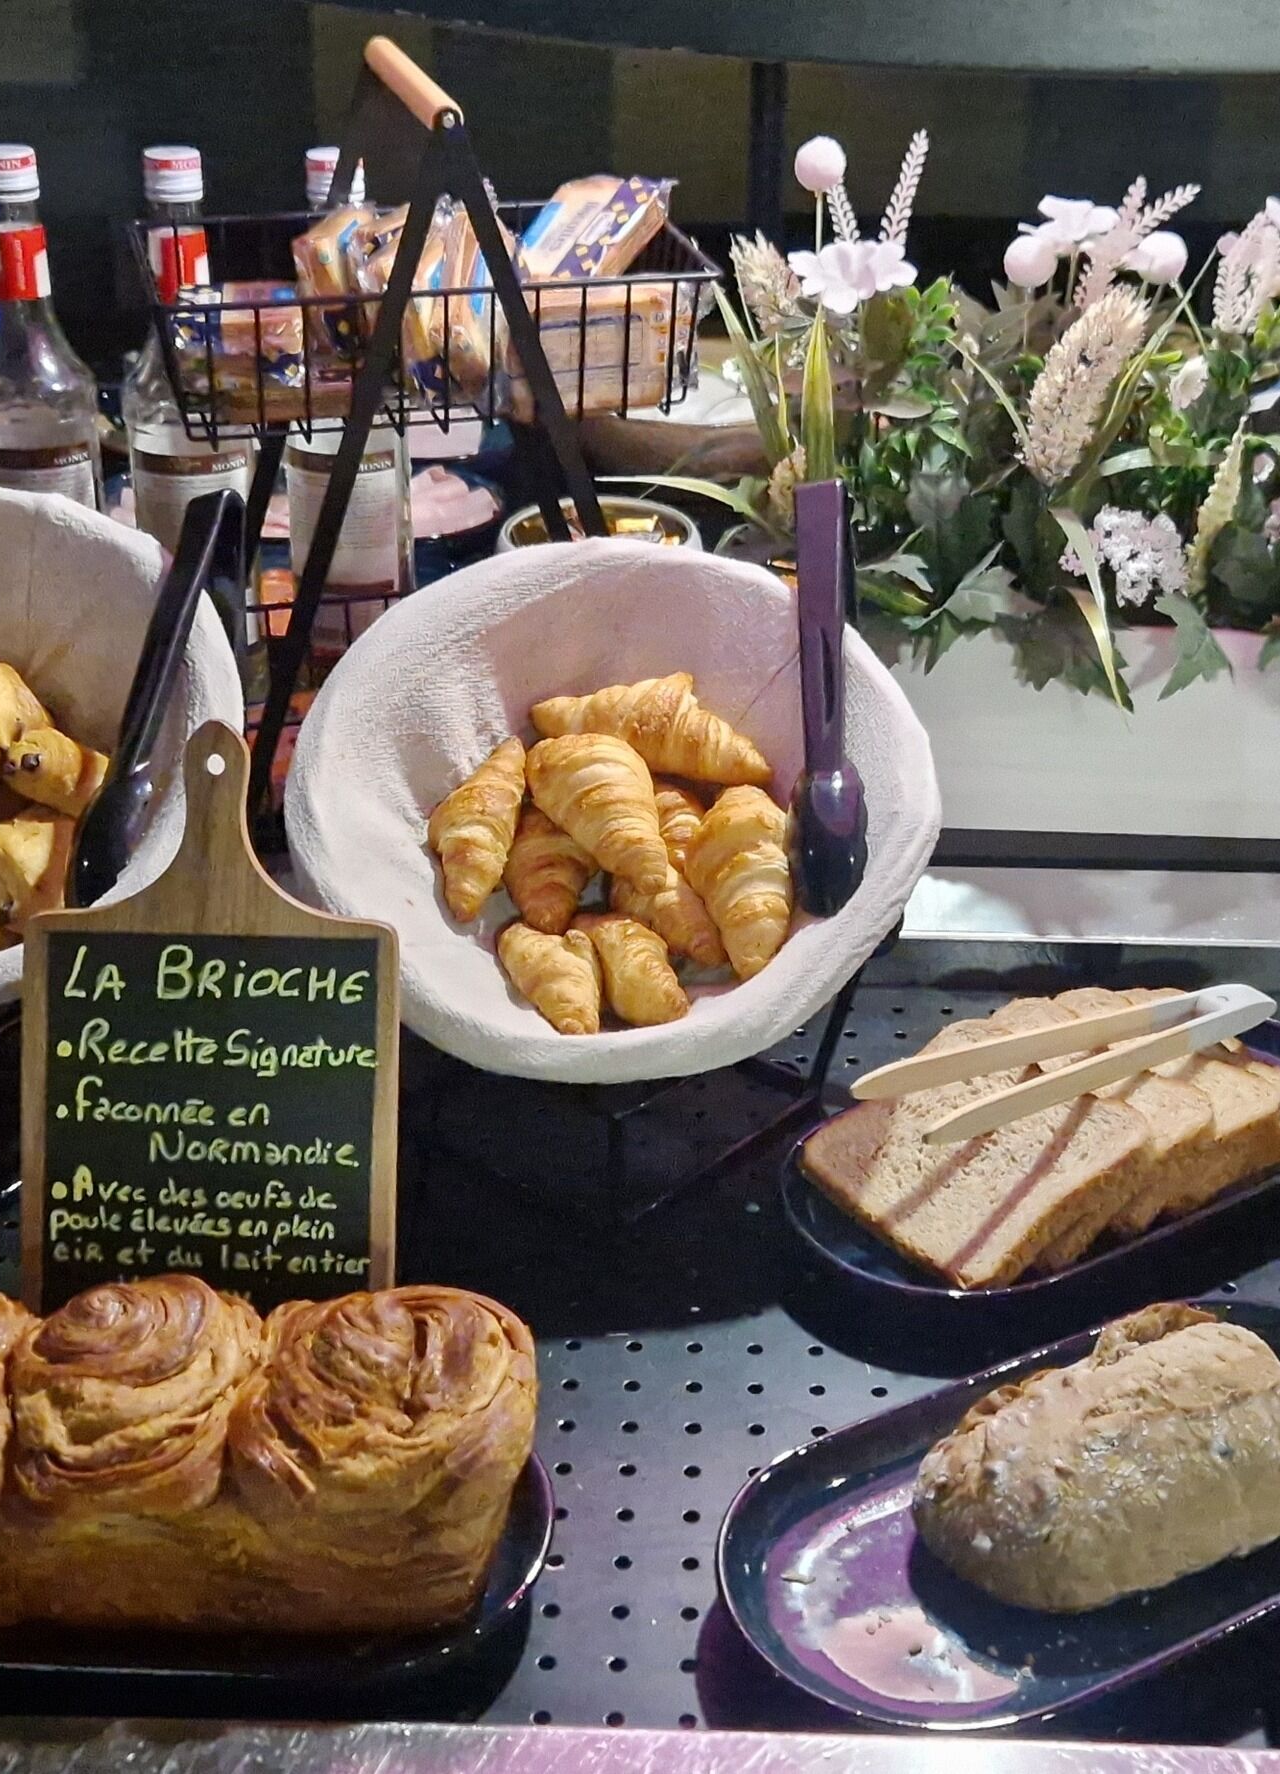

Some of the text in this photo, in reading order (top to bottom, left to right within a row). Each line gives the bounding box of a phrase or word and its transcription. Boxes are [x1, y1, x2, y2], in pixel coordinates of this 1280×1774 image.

[53, 453, 89, 467] MONIN
[211, 457, 247, 473] MONIN
[65, 945, 125, 1000] LA
[79, 1018, 378, 1077] Recette Signature
[228, 1102, 270, 1126] en
[73, 1164, 146, 1202] Avec
[159, 1178, 207, 1208] des
[298, 1186, 337, 1210] de
[50, 1206, 335, 1246] poule élevées en plein
[117, 1238, 155, 1265] et
[166, 1247, 203, 1268] du
[221, 1244, 282, 1271] lait
[287, 1254, 371, 1274] entier
